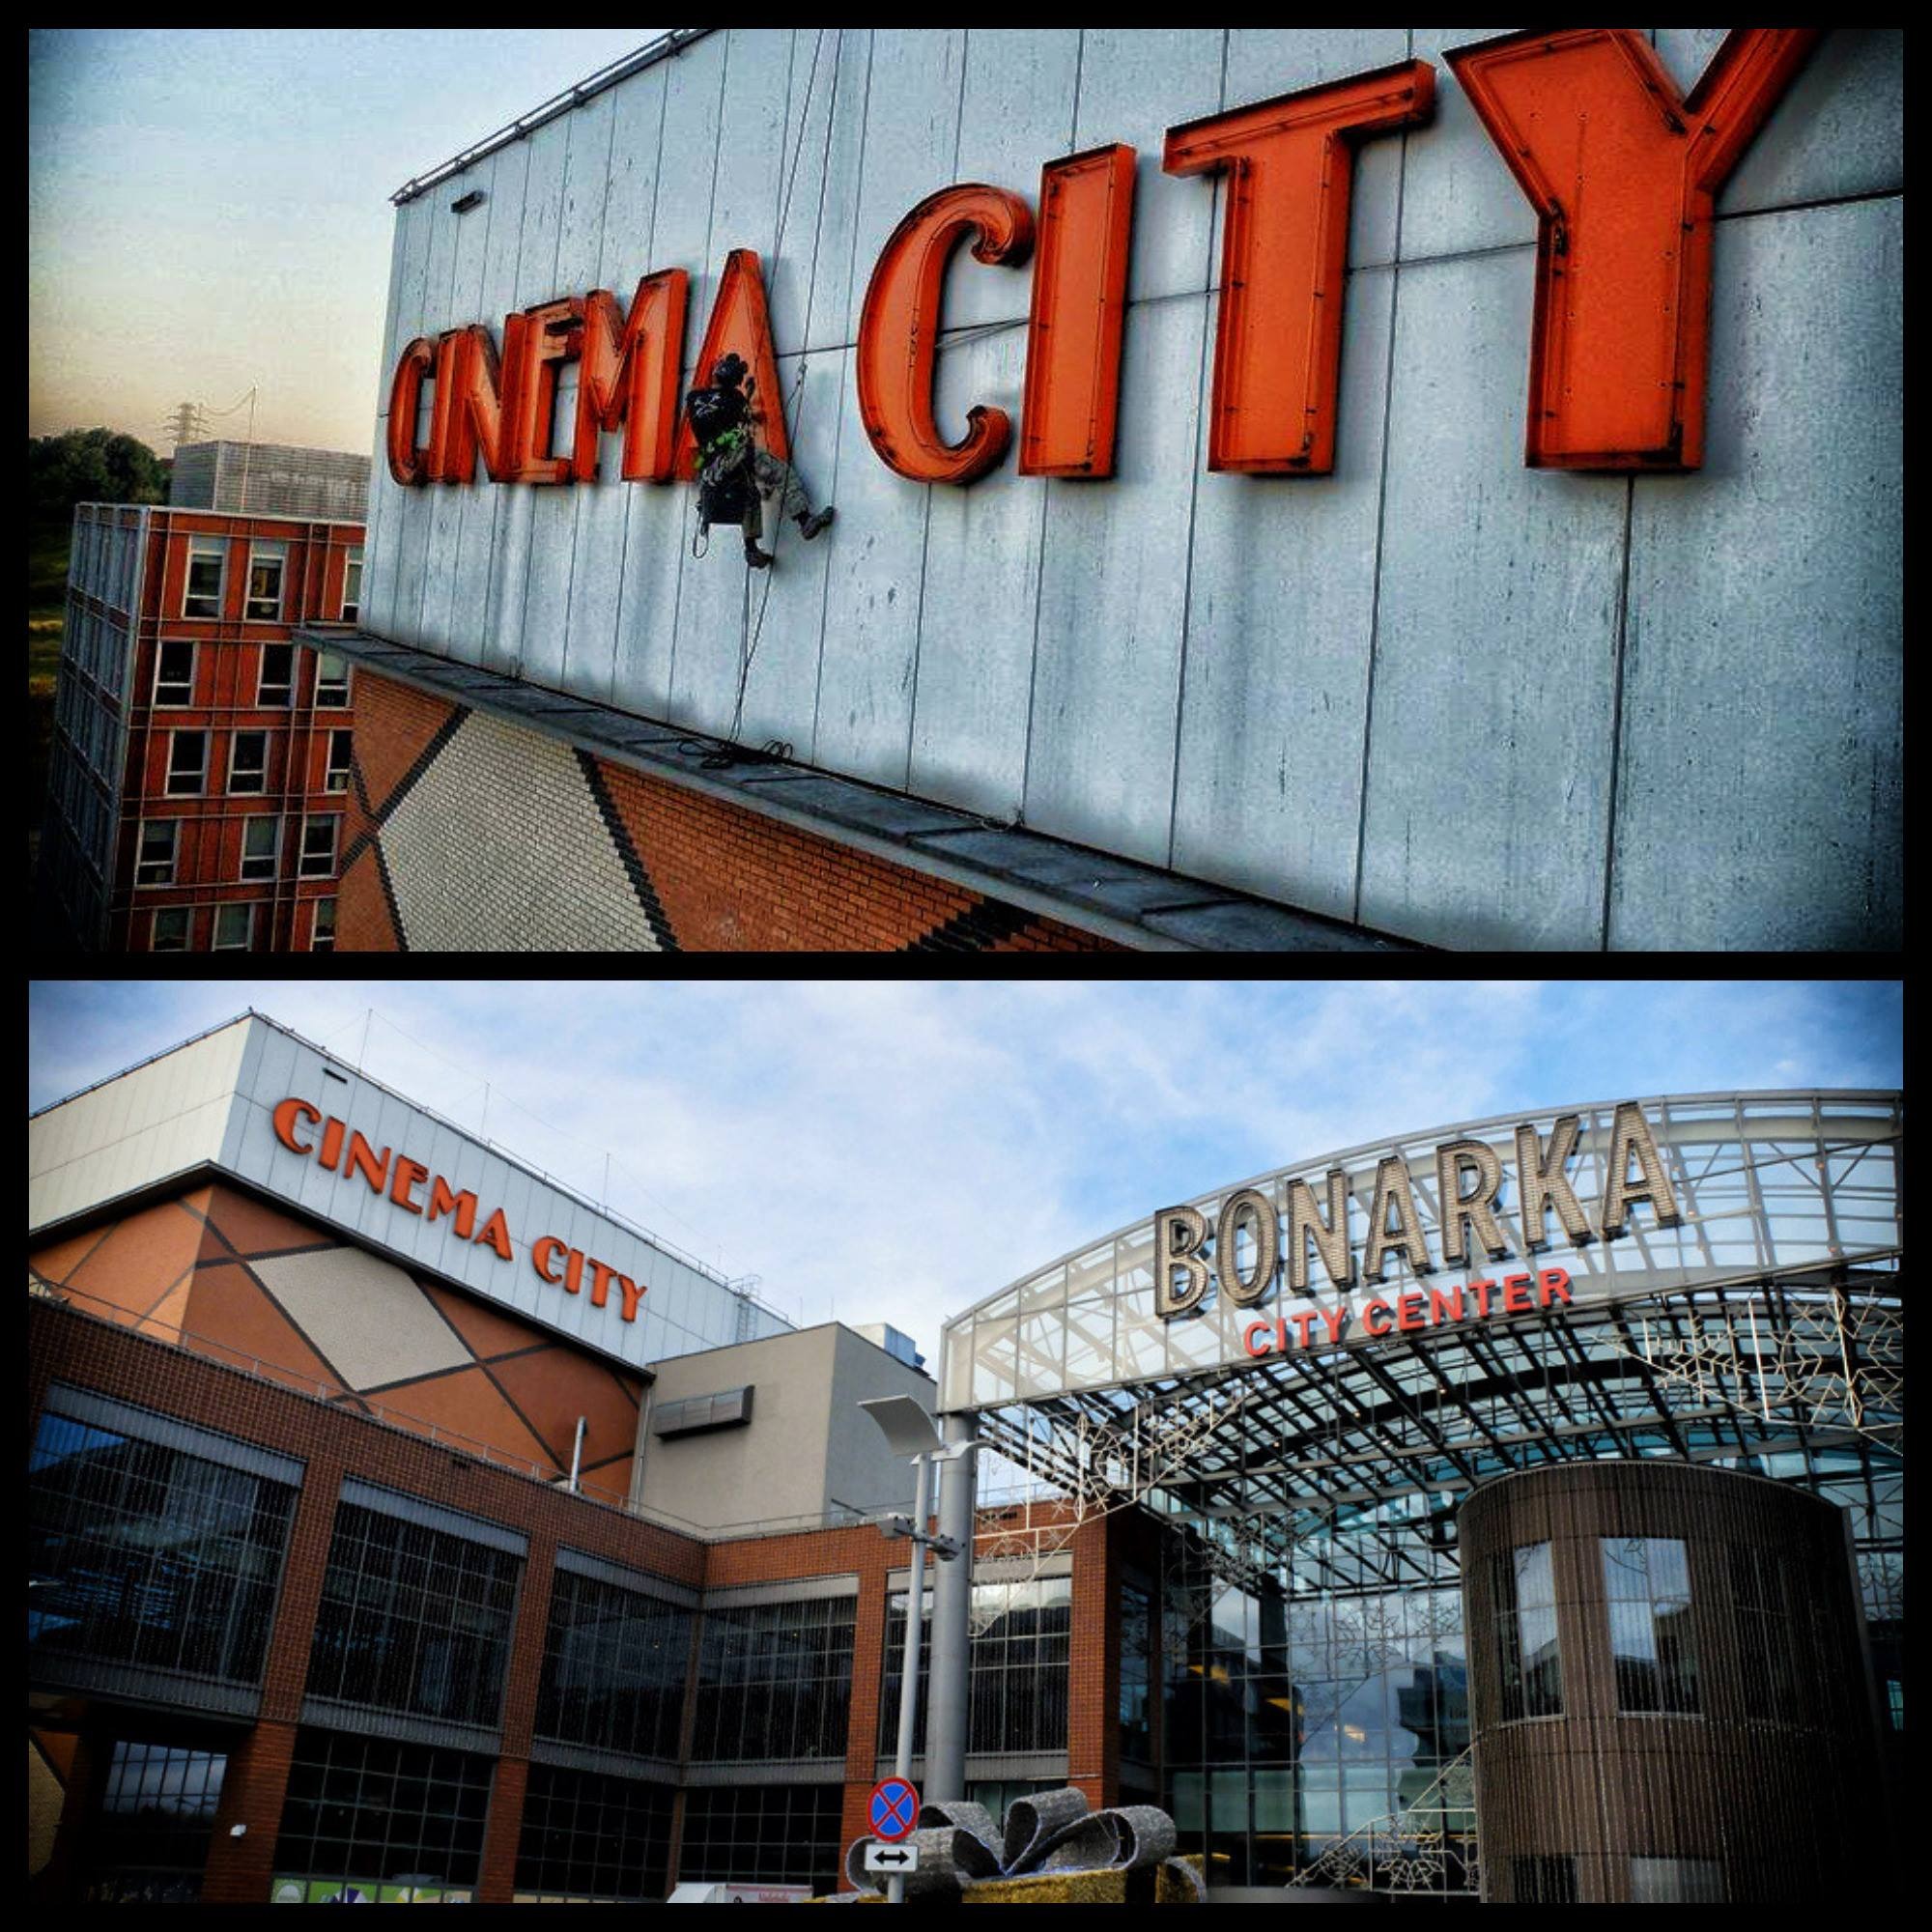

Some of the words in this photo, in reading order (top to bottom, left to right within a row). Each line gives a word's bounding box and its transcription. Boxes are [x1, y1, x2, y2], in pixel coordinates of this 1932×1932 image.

[386, 247, 790, 487] CINEMA
[855, 28, 1823, 488] CITY
[272, 1097, 514, 1262] CINEMA
[532, 1236, 647, 1322] CITY
[1154, 1099, 1682, 1320] BONARKA
[1244, 1306, 1346, 1357] CITY
[1362, 1267, 1574, 1337] CENTER
